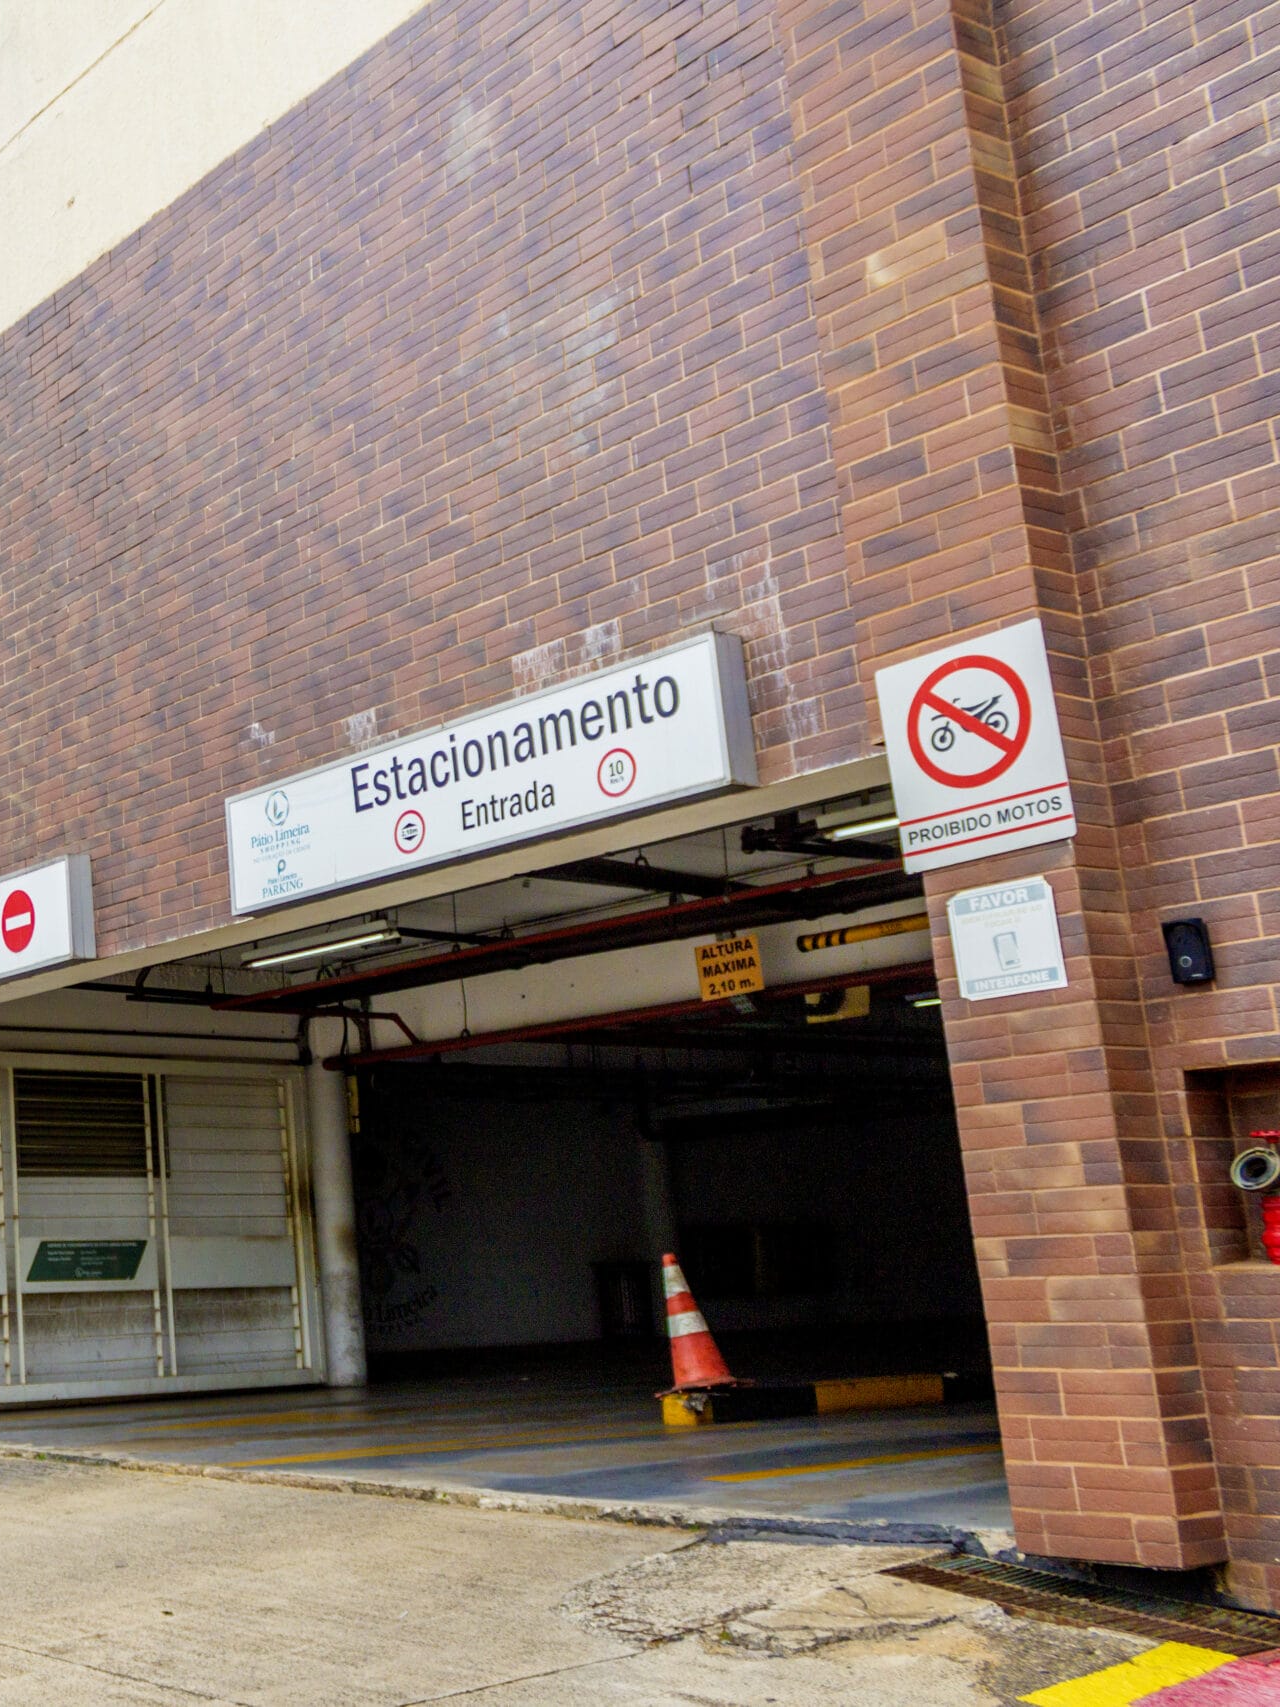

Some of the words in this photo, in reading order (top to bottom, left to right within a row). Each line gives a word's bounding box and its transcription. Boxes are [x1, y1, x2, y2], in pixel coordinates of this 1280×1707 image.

[351, 674, 681, 814] Estacionamento
[609, 760, 624, 778] 10
[462, 780, 556, 831] Entrada
[908, 813, 992, 846] PROIBIDO
[997, 796, 1063, 825] MOTOS
[251, 834, 274, 849] Pátio
[275, 824, 310, 842] Limeira
[262, 878, 303, 899] PARKING
[969, 887, 1029, 912] FAVOR
[701, 939, 753, 960] ALTURA
[703, 957, 756, 978] MAXIMA
[709, 979, 736, 995] 2,10
[974, 970, 1050, 991] INTERFONE
